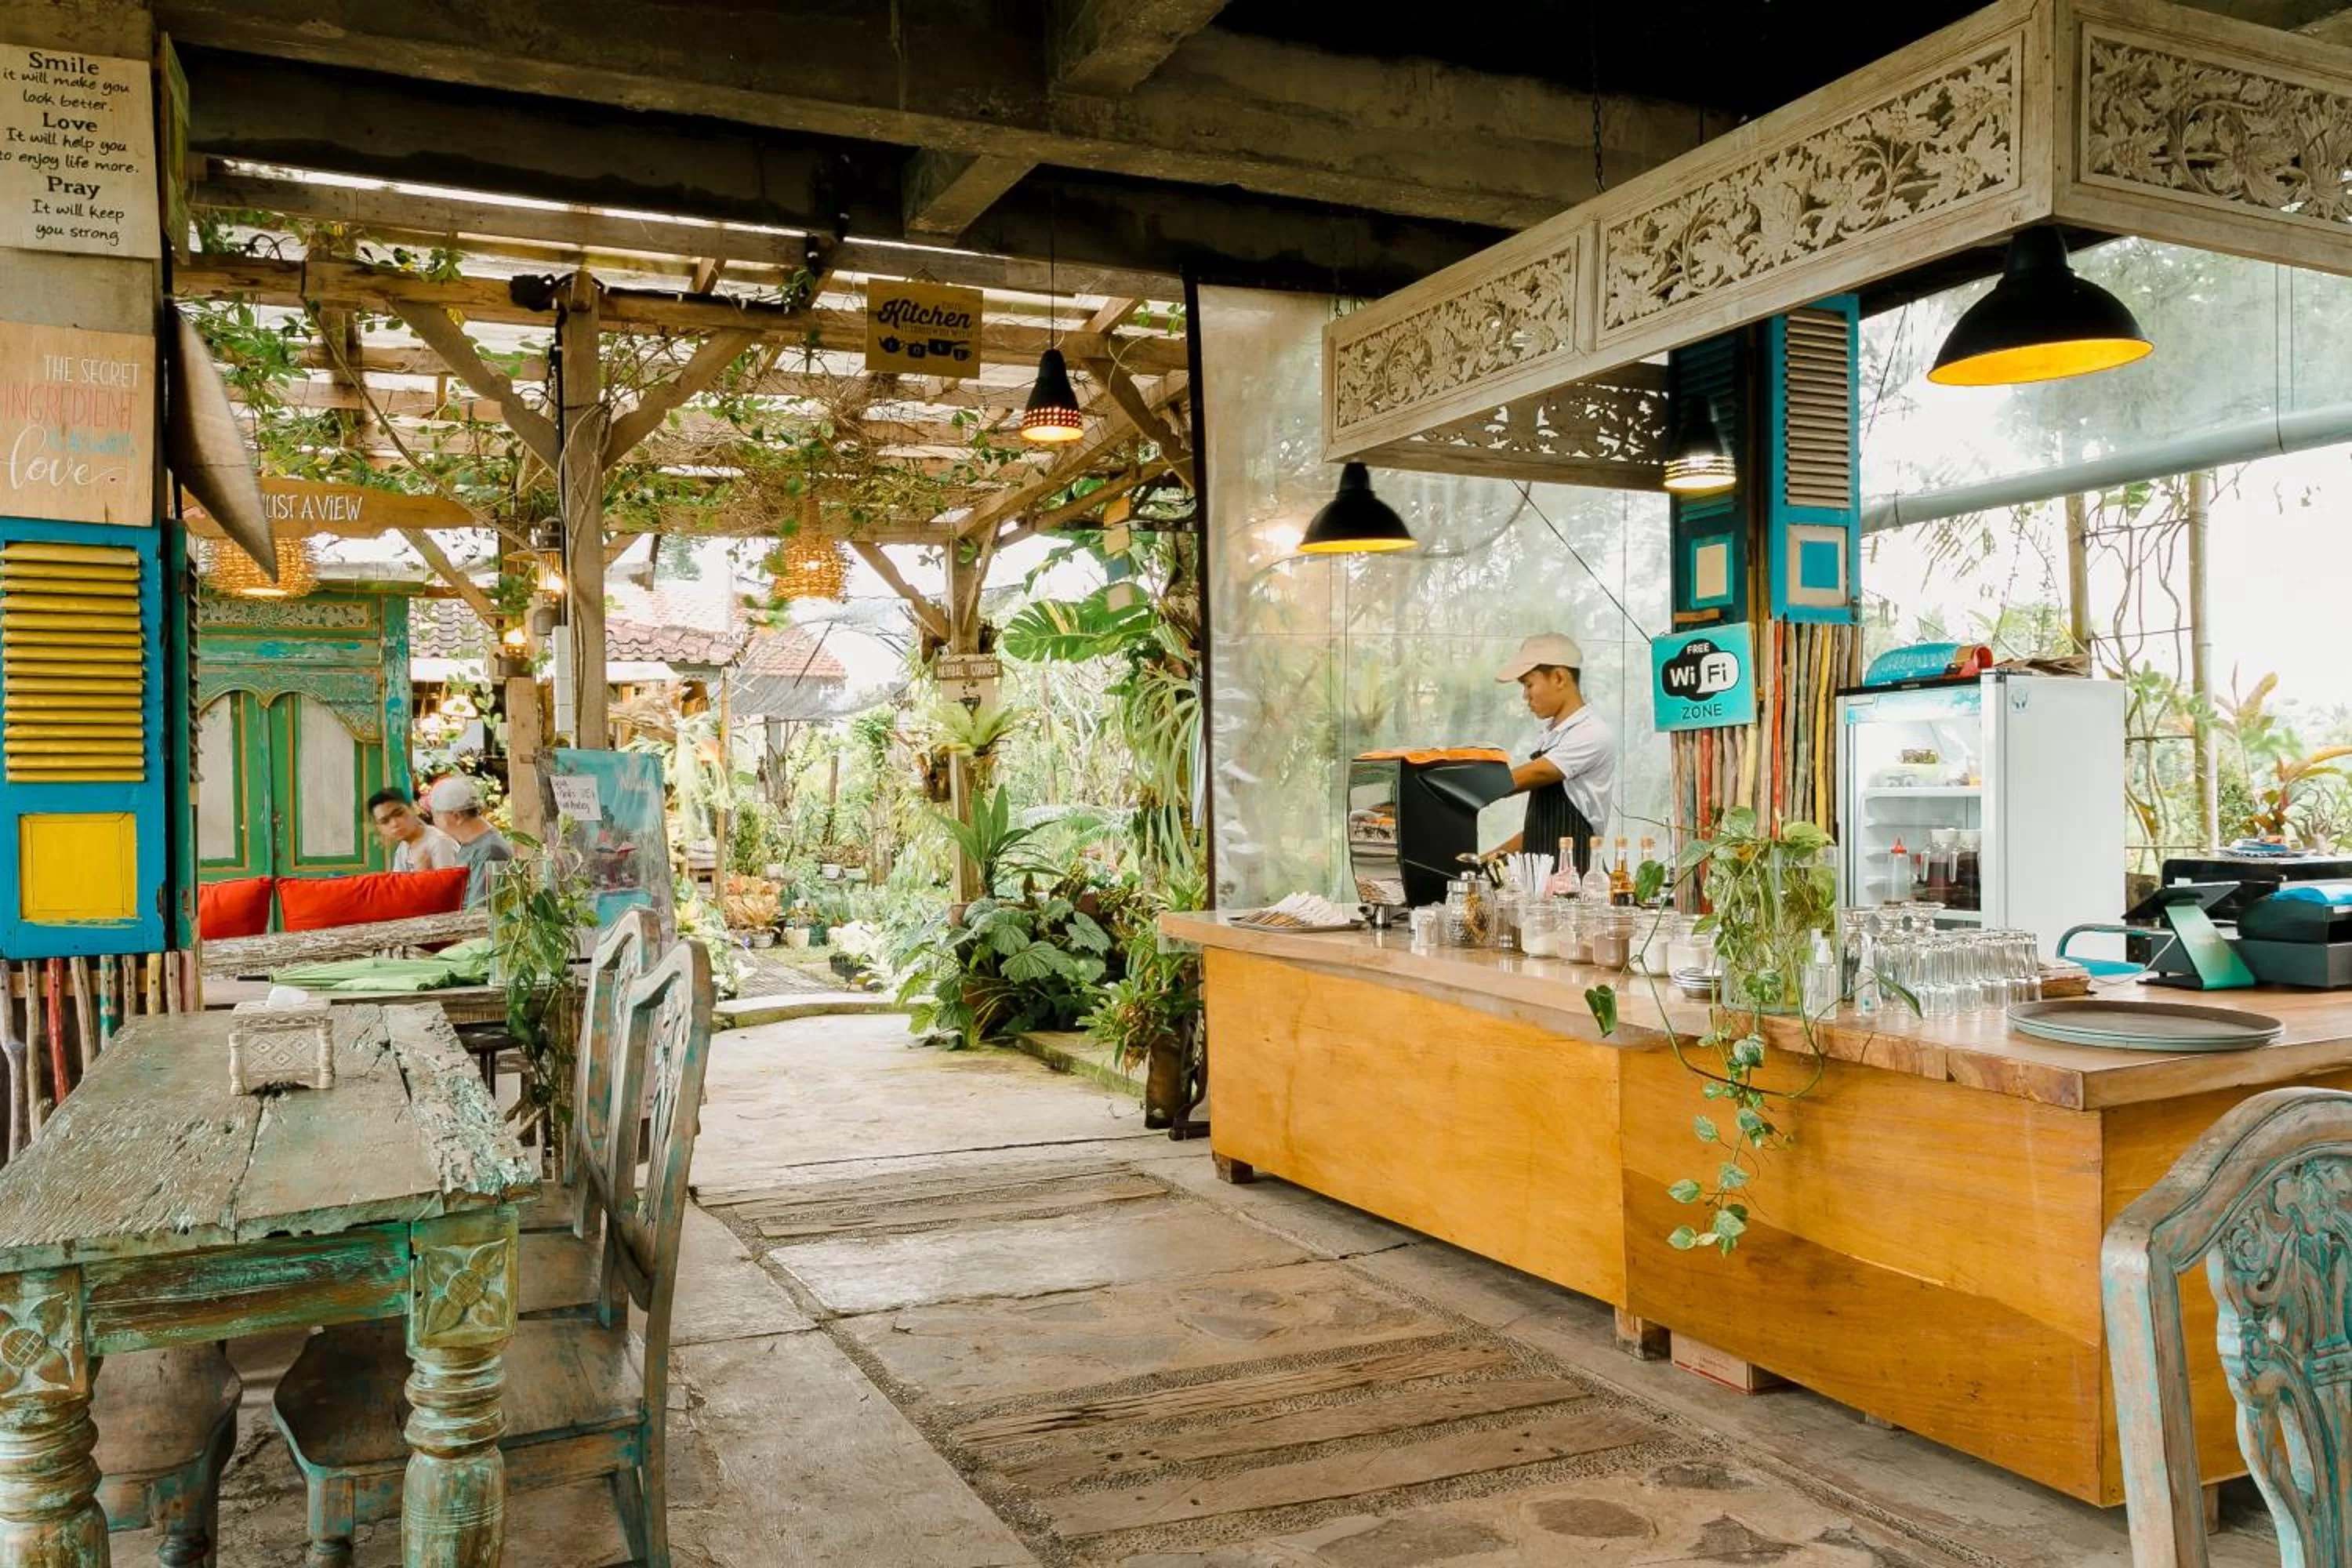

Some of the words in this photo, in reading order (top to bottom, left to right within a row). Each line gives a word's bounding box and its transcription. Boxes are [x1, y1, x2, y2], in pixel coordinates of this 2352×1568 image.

[28, 51, 100, 75] Smile
[3, 67, 16, 81] it
[22, 72, 49, 85] will
[53, 76, 96, 90] make
[103, 81, 130, 96] you
[23, 89, 56, 107] look
[60, 95, 114, 113] better.
[42, 111, 99, 133] Love
[6, 128, 26, 143] It
[30, 132, 58, 147] will
[63, 136, 95, 153] help
[100, 140, 127, 156] you
[19, 151, 60, 170] enjoy
[65, 153, 89, 169] life
[95, 162, 140, 174] more.
[46, 175, 101, 201] Pray
[31, 198, 51, 215] It
[56, 204, 84, 218] will
[89, 205, 125, 221] keep
[35, 225, 64, 240] you
[70, 226, 119, 247] strong
[877, 298, 972, 329] Kitchen
[44, 355, 73, 382] THE
[81, 358, 140, 387] SECRET
[262, 493, 298, 520] UST
[299, 494, 314, 520] A
[314, 495, 362, 521] VIEW
[1686, 642, 1710, 655] FREE
[1682, 702, 1722, 720] ZONE
